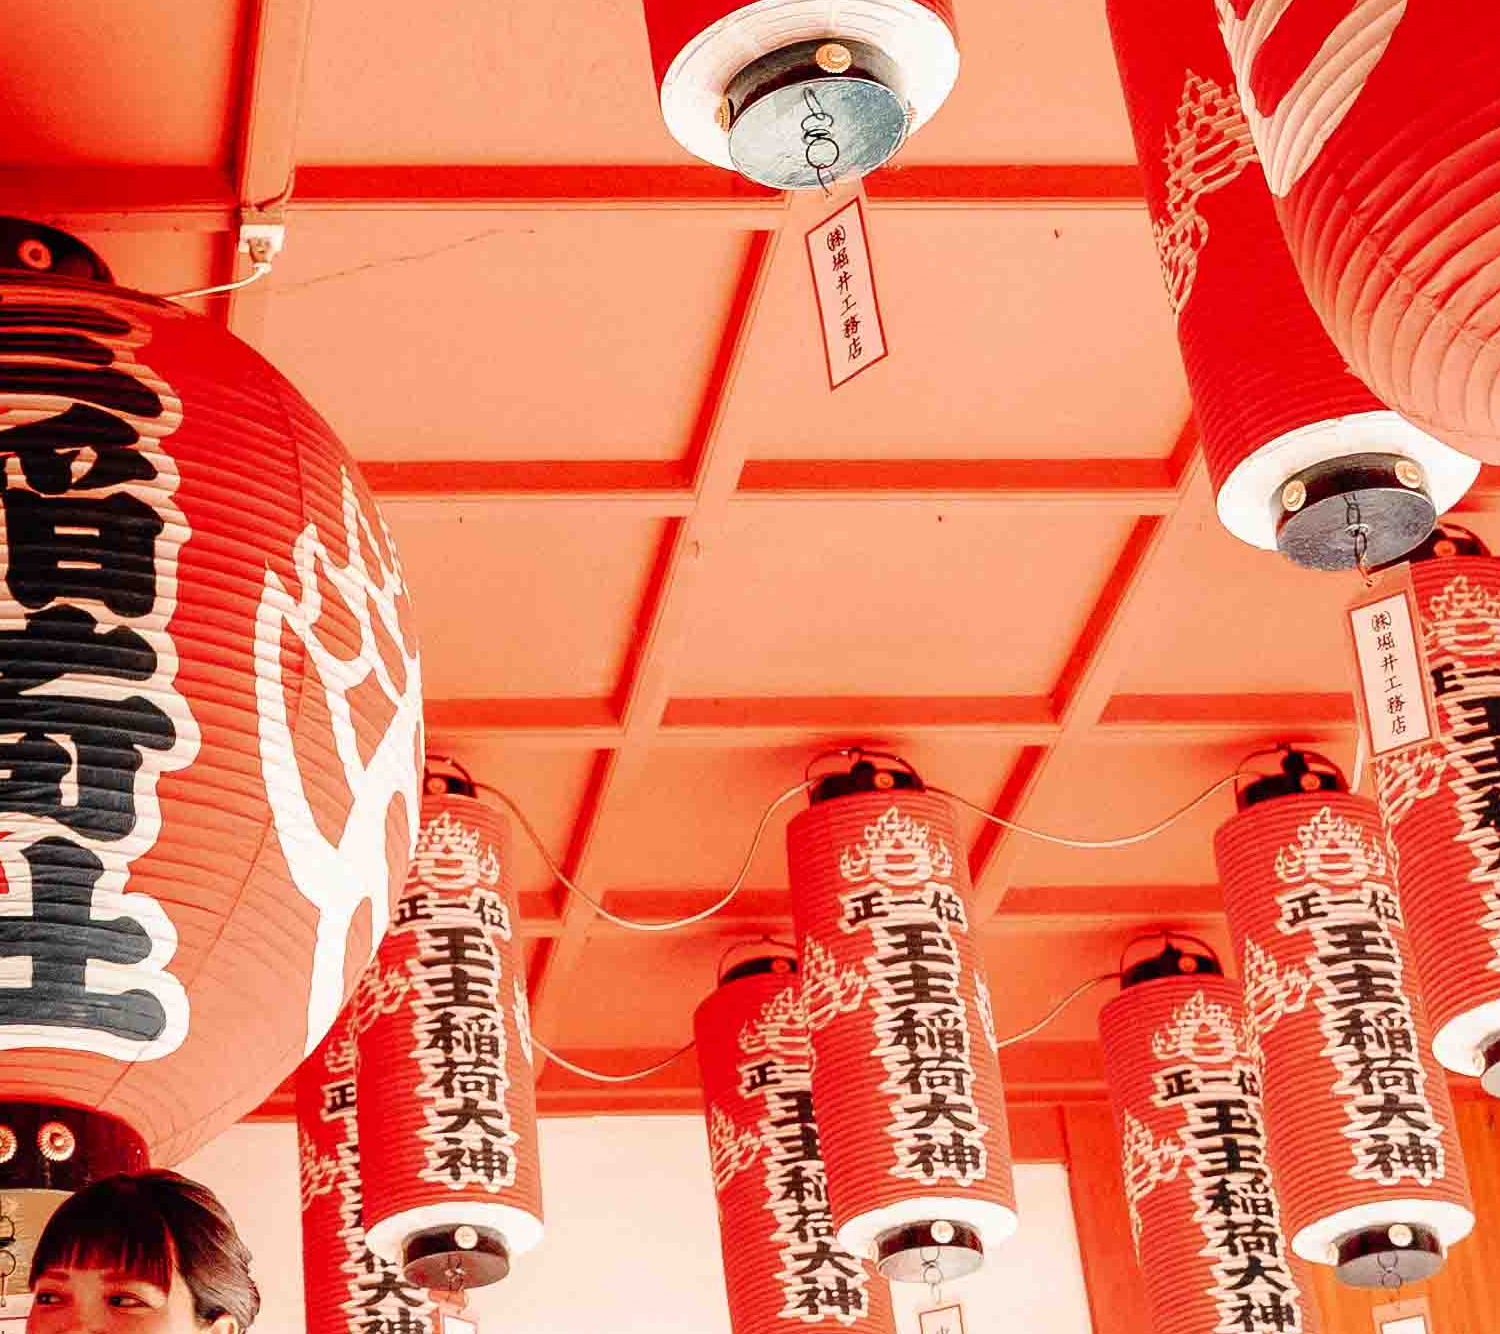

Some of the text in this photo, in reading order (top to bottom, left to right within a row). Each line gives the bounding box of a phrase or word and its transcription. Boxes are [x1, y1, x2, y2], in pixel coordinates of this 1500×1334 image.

[394, 891, 509, 931] 正一位
[846, 892, 967, 929] 正一位
[422, 925, 511, 1184] 玉主稲荷大神
[743, 1060, 812, 1093] 正一
[889, 922, 986, 1181] 玉主稲荷大神
[1323, 921, 1440, 1180] 玉主稲荷大神
